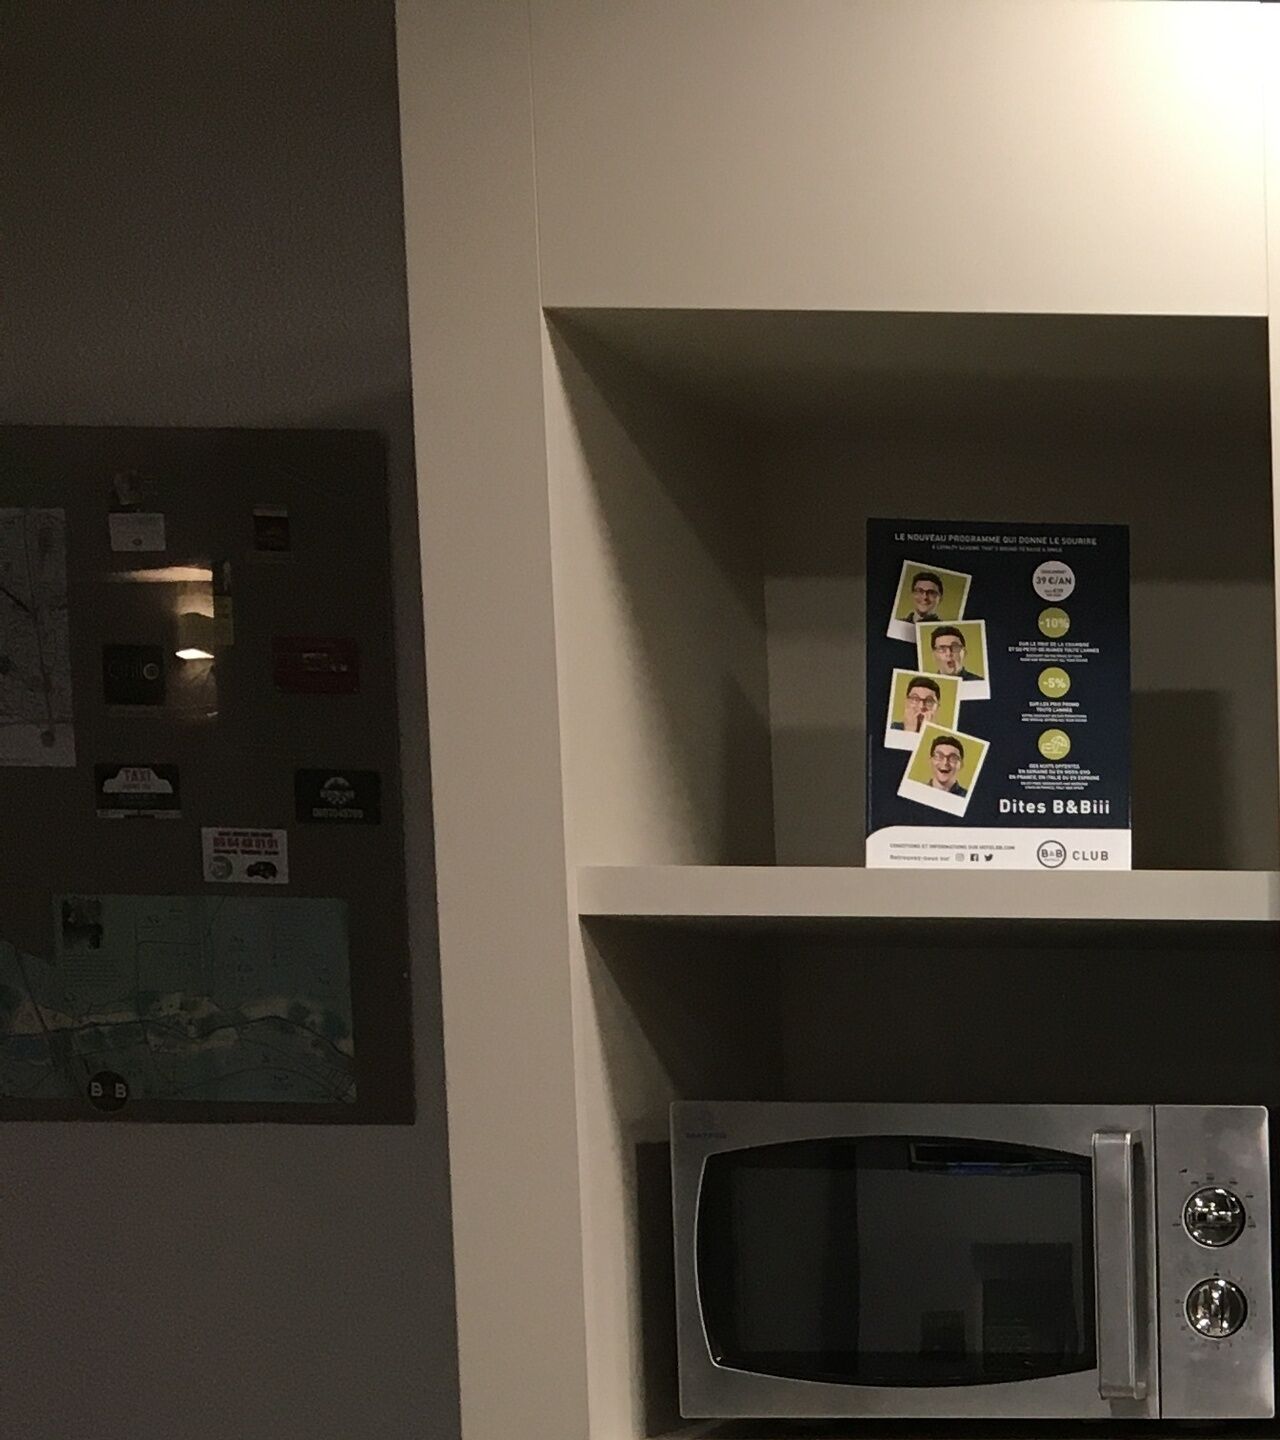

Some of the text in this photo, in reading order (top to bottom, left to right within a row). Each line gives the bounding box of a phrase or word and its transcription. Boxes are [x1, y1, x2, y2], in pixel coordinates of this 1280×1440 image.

[894, 532, 905, 542] LE
[907, 532, 947, 542] NOUVEAU
[948, 533, 1000, 544] PROGRAMME
[1036, 576, 1047, 585] 39
[1039, 617, 1070, 630] -10%
[1042, 677, 1067, 689] -5%
[999, 798, 1110, 815] Dites B&Biii
[1072, 851, 1109, 861] CLUB
